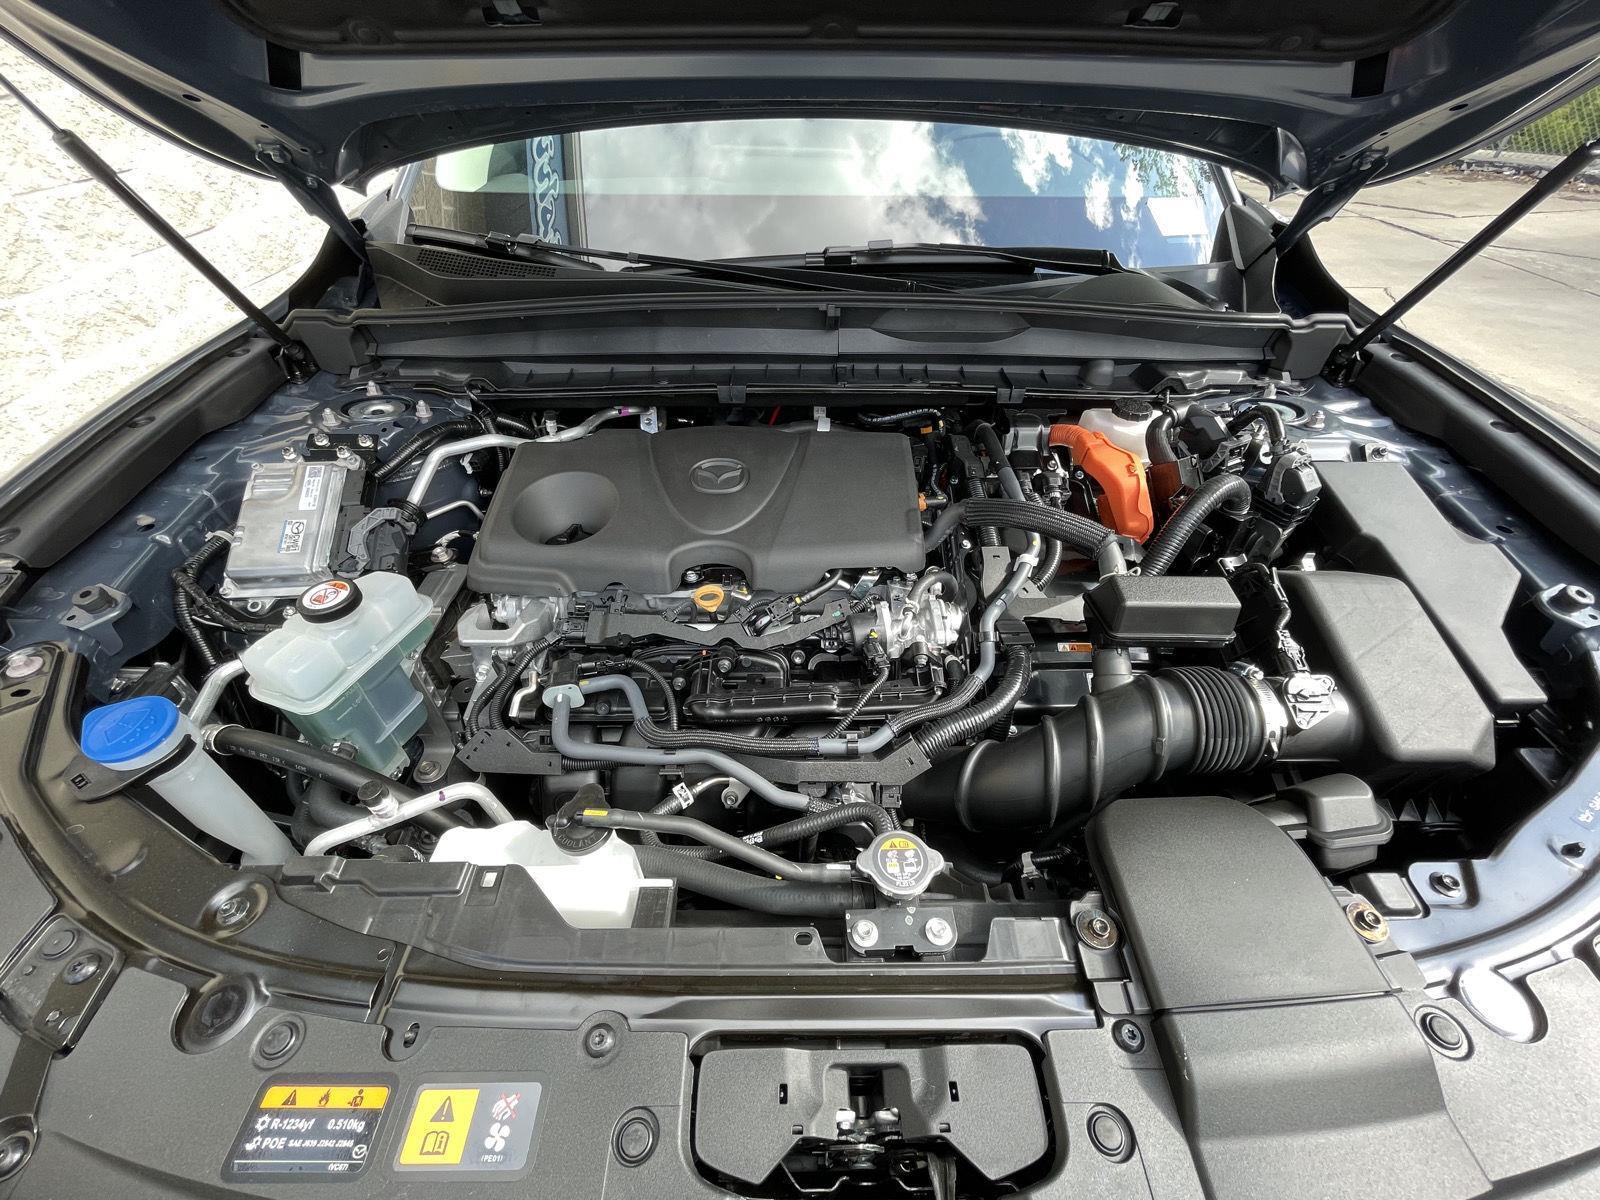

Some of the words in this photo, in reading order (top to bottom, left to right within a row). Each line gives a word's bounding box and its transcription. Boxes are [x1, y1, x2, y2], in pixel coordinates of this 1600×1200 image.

[558, 833, 597, 848] COOLANT
[327, 1118, 366, 1132] 0.510kg
[262, 1137, 288, 1149] POE
